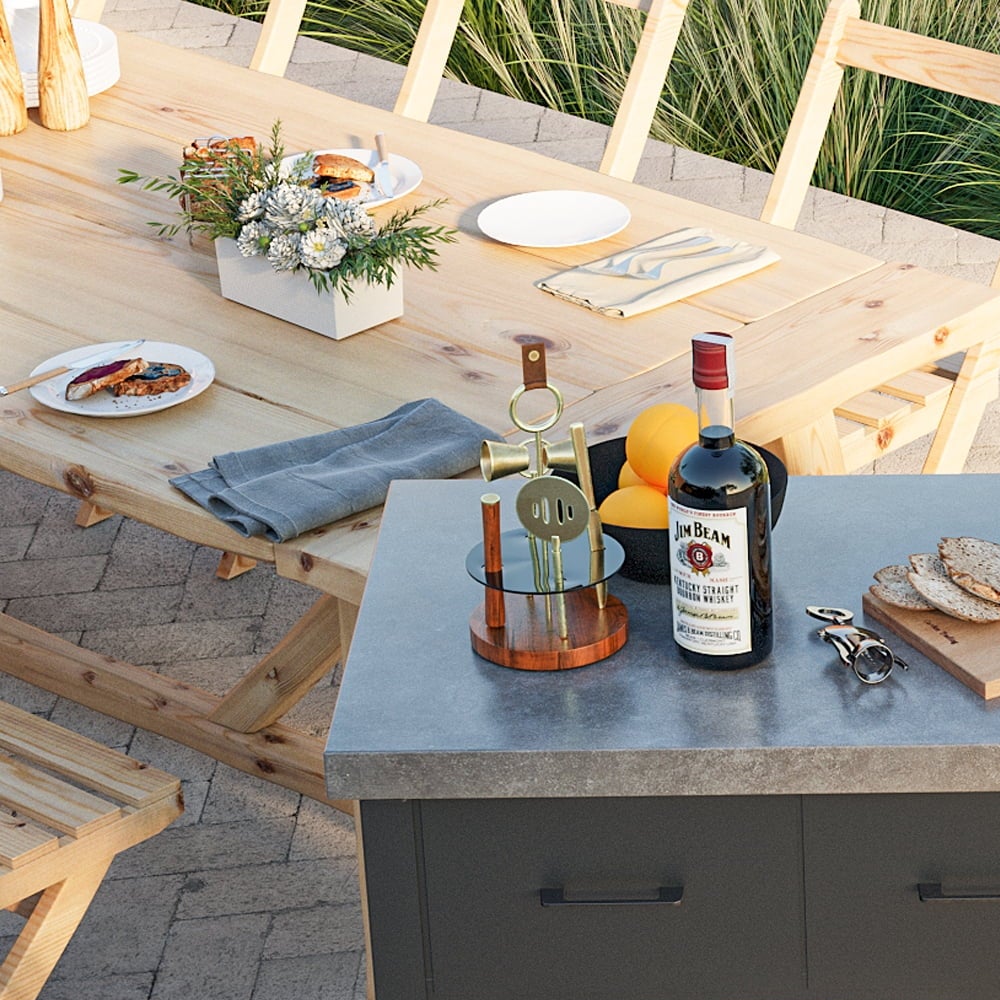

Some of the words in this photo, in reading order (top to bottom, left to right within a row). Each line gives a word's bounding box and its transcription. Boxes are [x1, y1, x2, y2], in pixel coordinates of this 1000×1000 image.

[674, 520, 691, 541] JIM
[694, 521, 731, 550] BEAM
[674, 575, 700, 593] KENTUCKY
[702, 584, 739, 595] STRAIGHT
[677, 586, 701, 602] BOURBON
[703, 594, 734, 604] WHISKEY
[704, 630, 733, 640] DISTILLING
